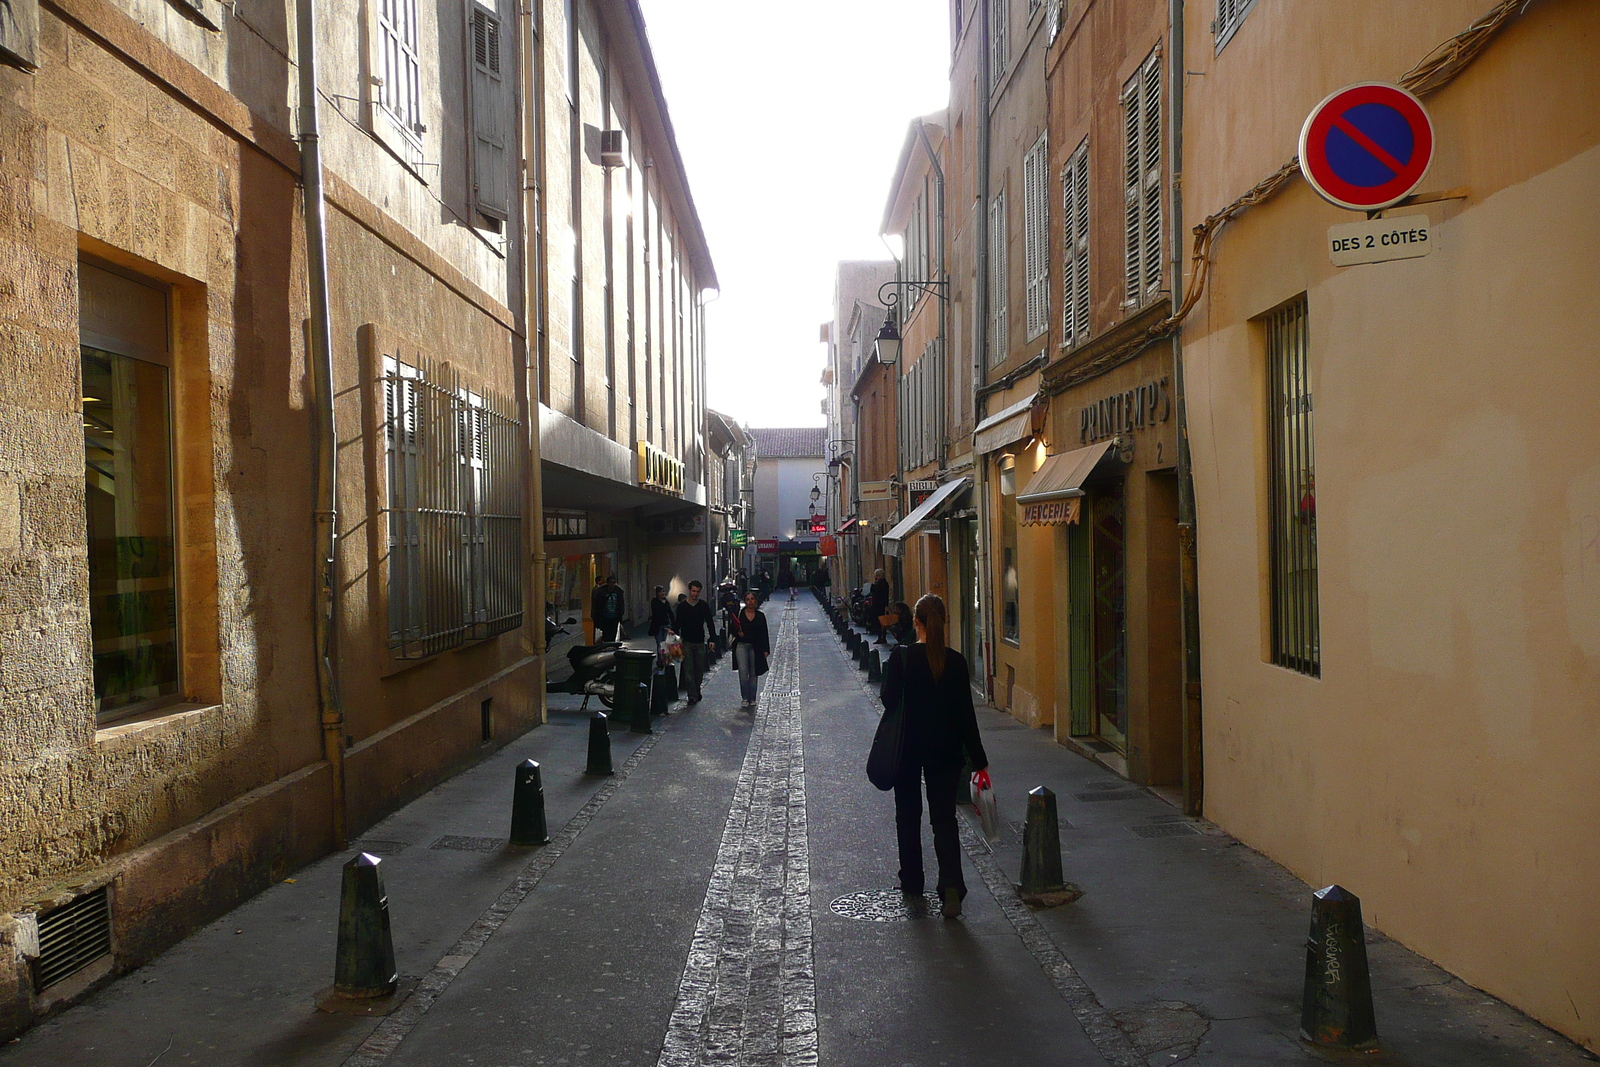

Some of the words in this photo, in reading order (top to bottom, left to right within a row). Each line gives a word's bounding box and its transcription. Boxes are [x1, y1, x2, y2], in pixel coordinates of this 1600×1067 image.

[1332, 237, 1360, 252] DES
[1365, 235, 1375, 248] 2
[1381, 228, 1428, 246] CÔTÉS
[1080, 376, 1171, 444] PRINTEMPS
[1157, 441, 1164, 465] 2
[910, 481, 940, 490] BIBLIA
[1024, 502, 1071, 520] MERCERIE
